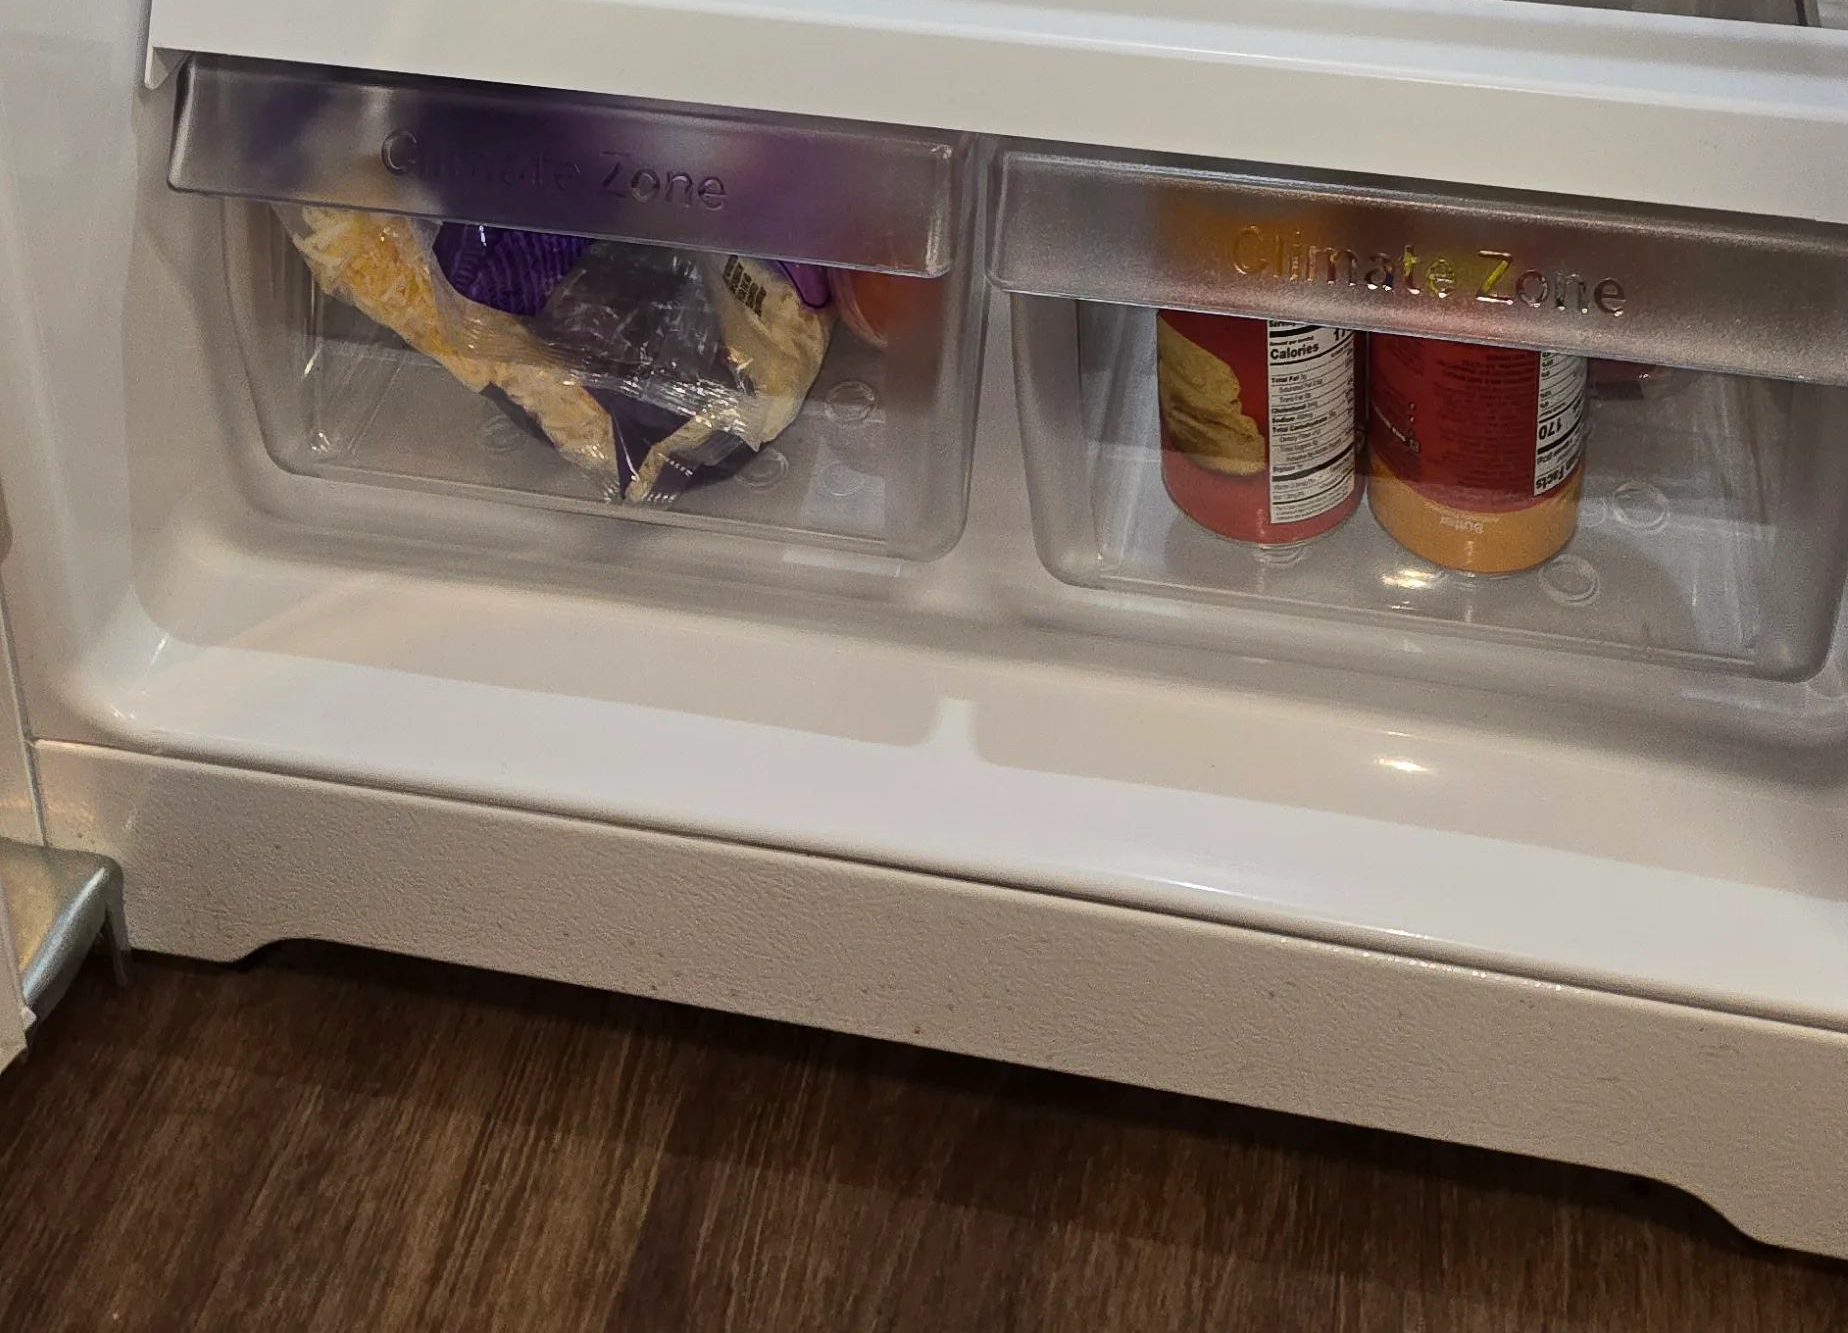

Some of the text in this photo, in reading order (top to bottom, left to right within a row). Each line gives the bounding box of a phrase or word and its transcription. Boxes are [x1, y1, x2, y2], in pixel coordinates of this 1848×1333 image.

[600, 150, 728, 212] Zone
[1231, 225, 1627, 317] Climate Zone
[1270, 342, 1319, 360] Calories
[1539, 418, 1562, 440] 170
[1535, 470, 1565, 489] Facts
[1440, 516, 1484, 534] Butter
